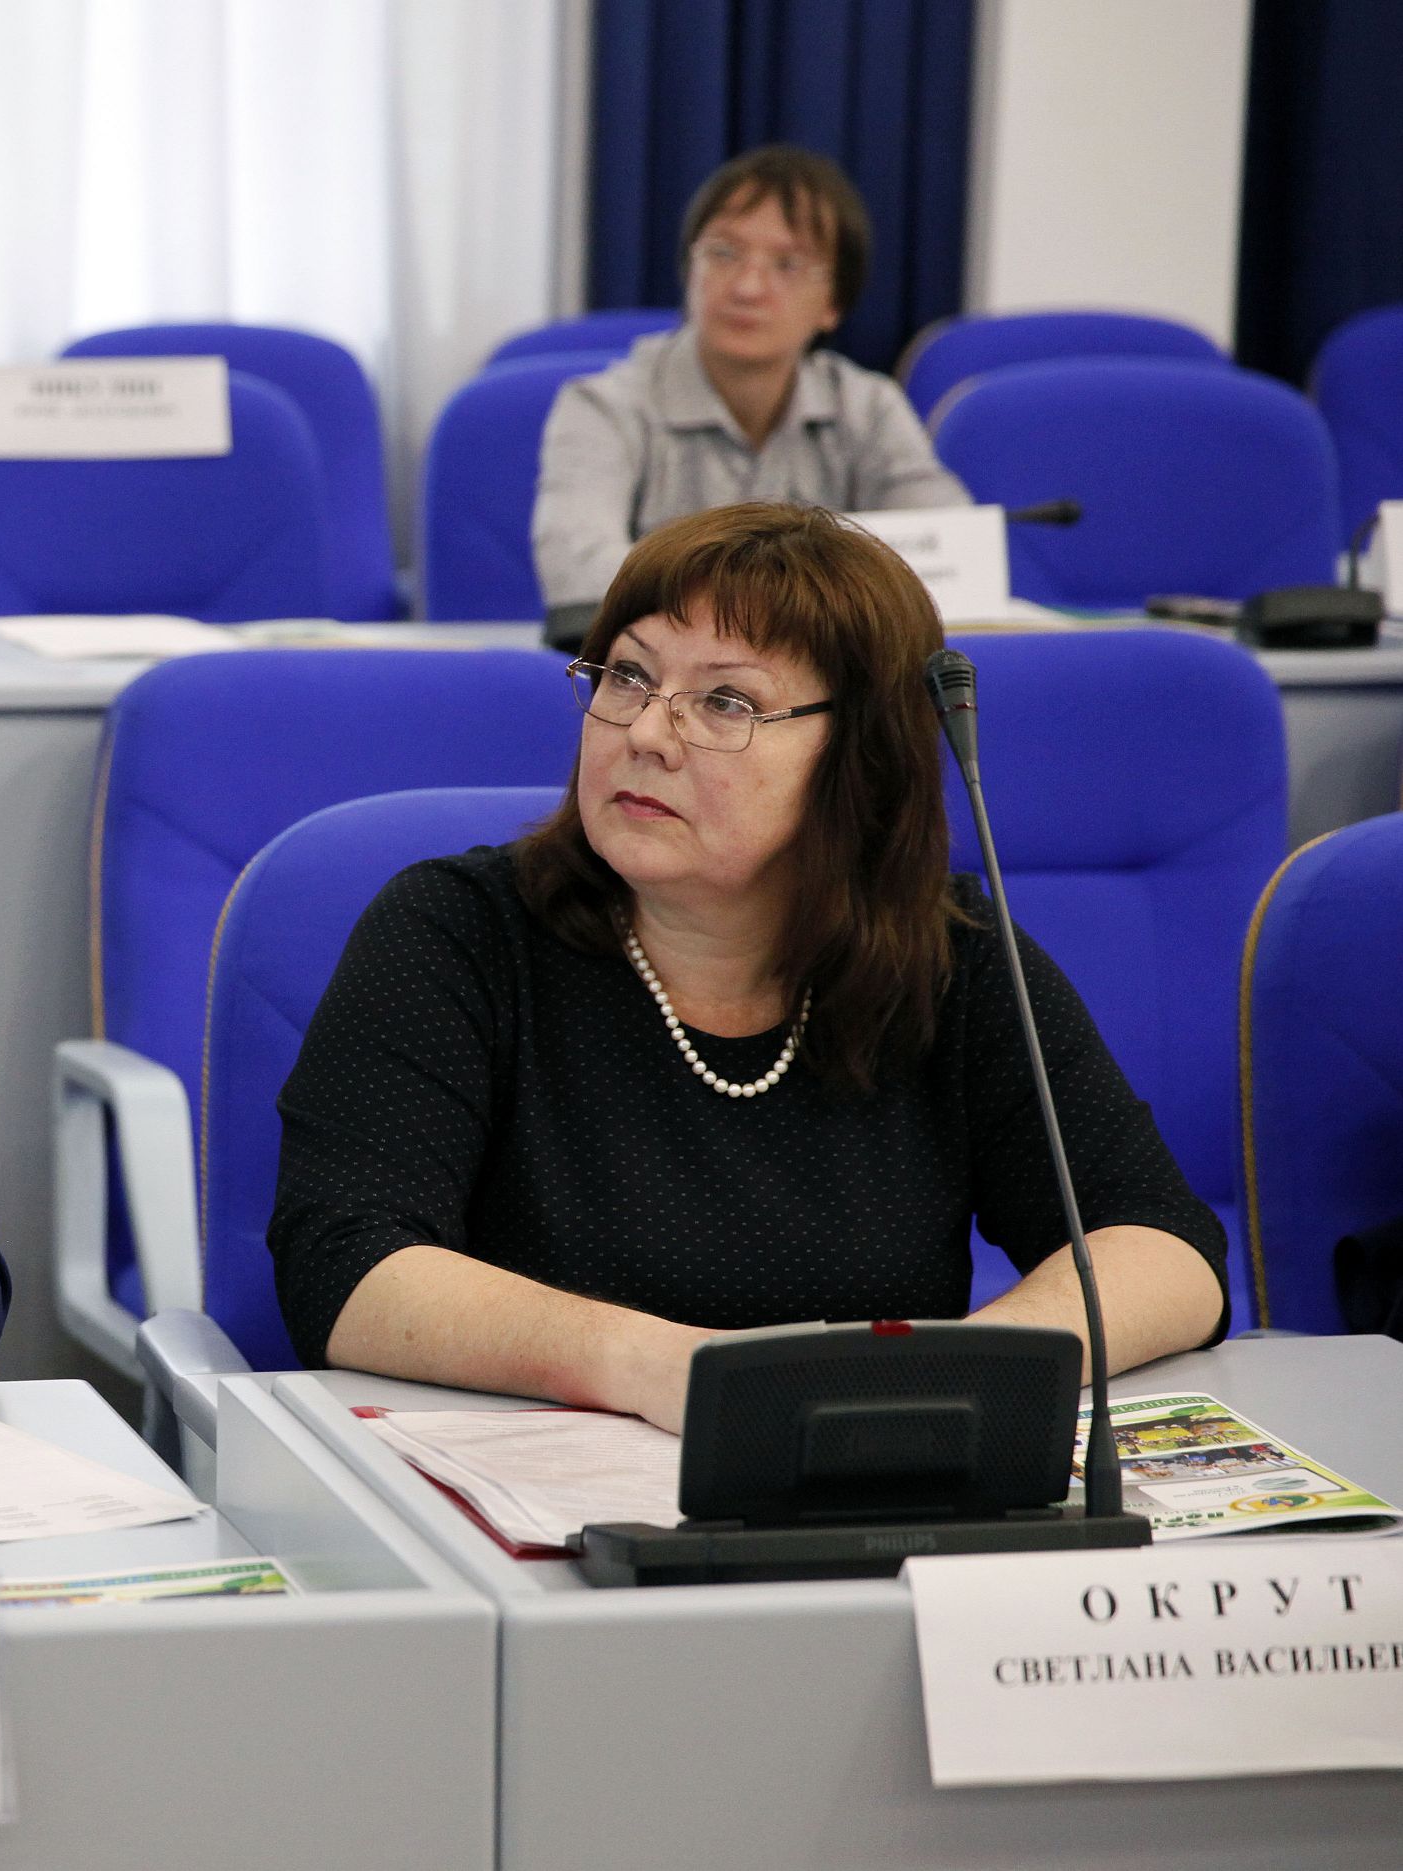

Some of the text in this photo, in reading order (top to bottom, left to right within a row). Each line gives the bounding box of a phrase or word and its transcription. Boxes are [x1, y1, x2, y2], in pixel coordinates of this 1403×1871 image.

[864, 1534, 938, 1551] PHILIPS
[1080, 1574, 1364, 1624] ОКРУТ
[994, 1650, 1195, 1689] СВЕТЛАНА
